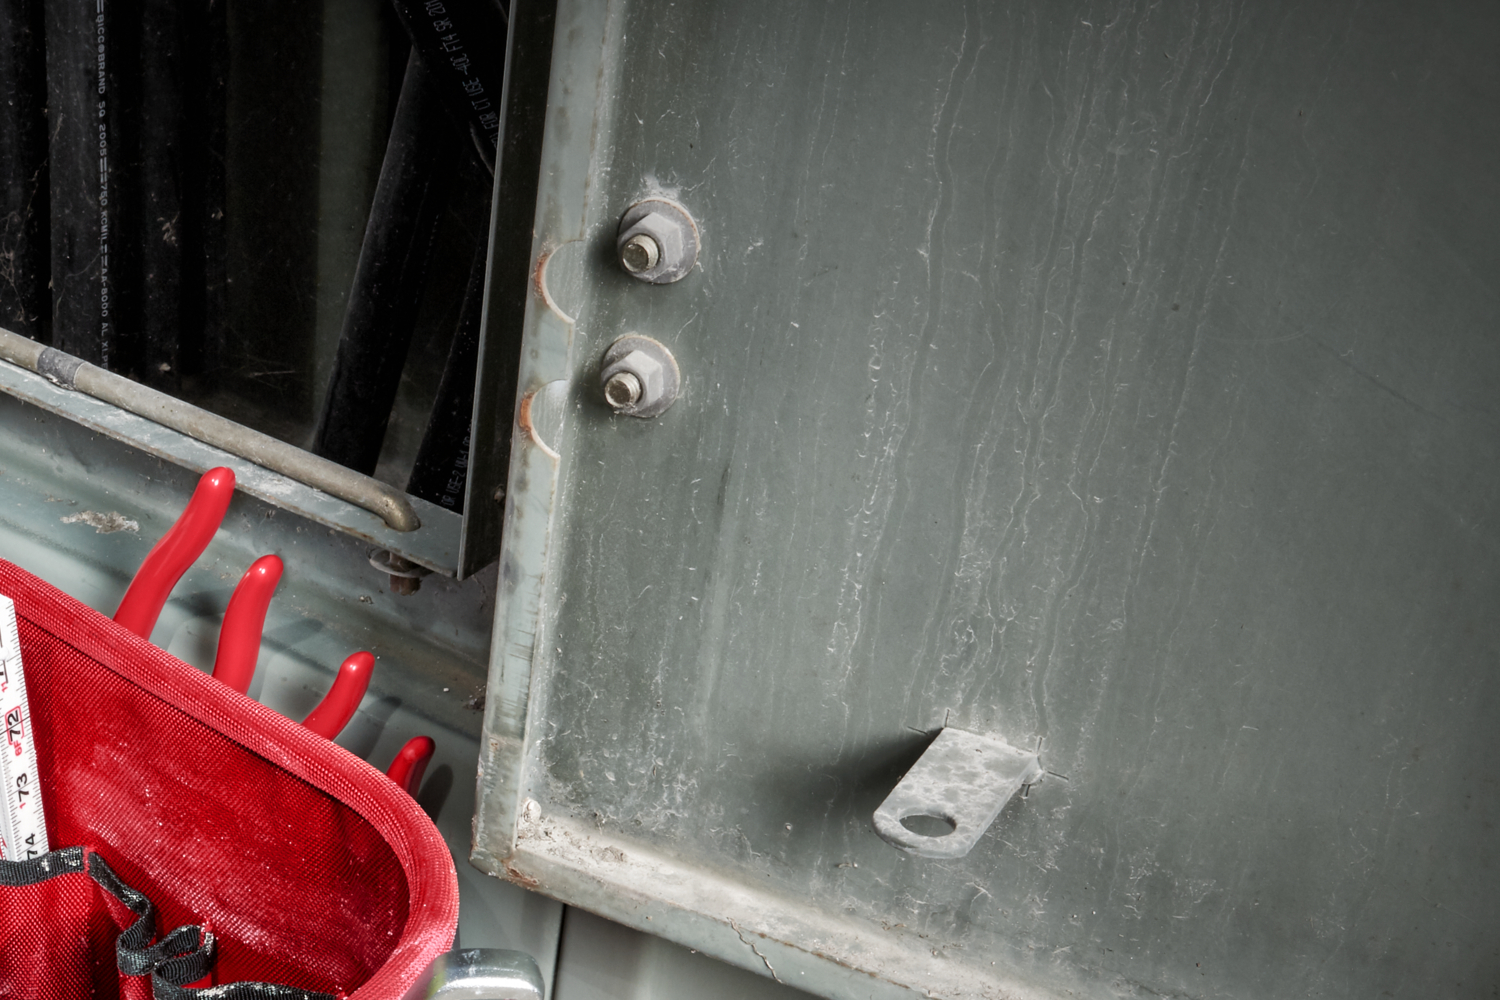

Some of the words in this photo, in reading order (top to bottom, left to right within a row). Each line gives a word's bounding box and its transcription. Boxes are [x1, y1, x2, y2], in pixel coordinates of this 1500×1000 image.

[99, 124, 108, 156] 2005
[100, 182, 109, 206] 750
[100, 210, 109, 244] KCMIL
[100, 268, 109, 317] AA-8000
[101, 322, 109, 337] AL
[8, 709, 20, 741] 72
[17, 772, 29, 802] 73
[26, 832, 37, 860] 74
